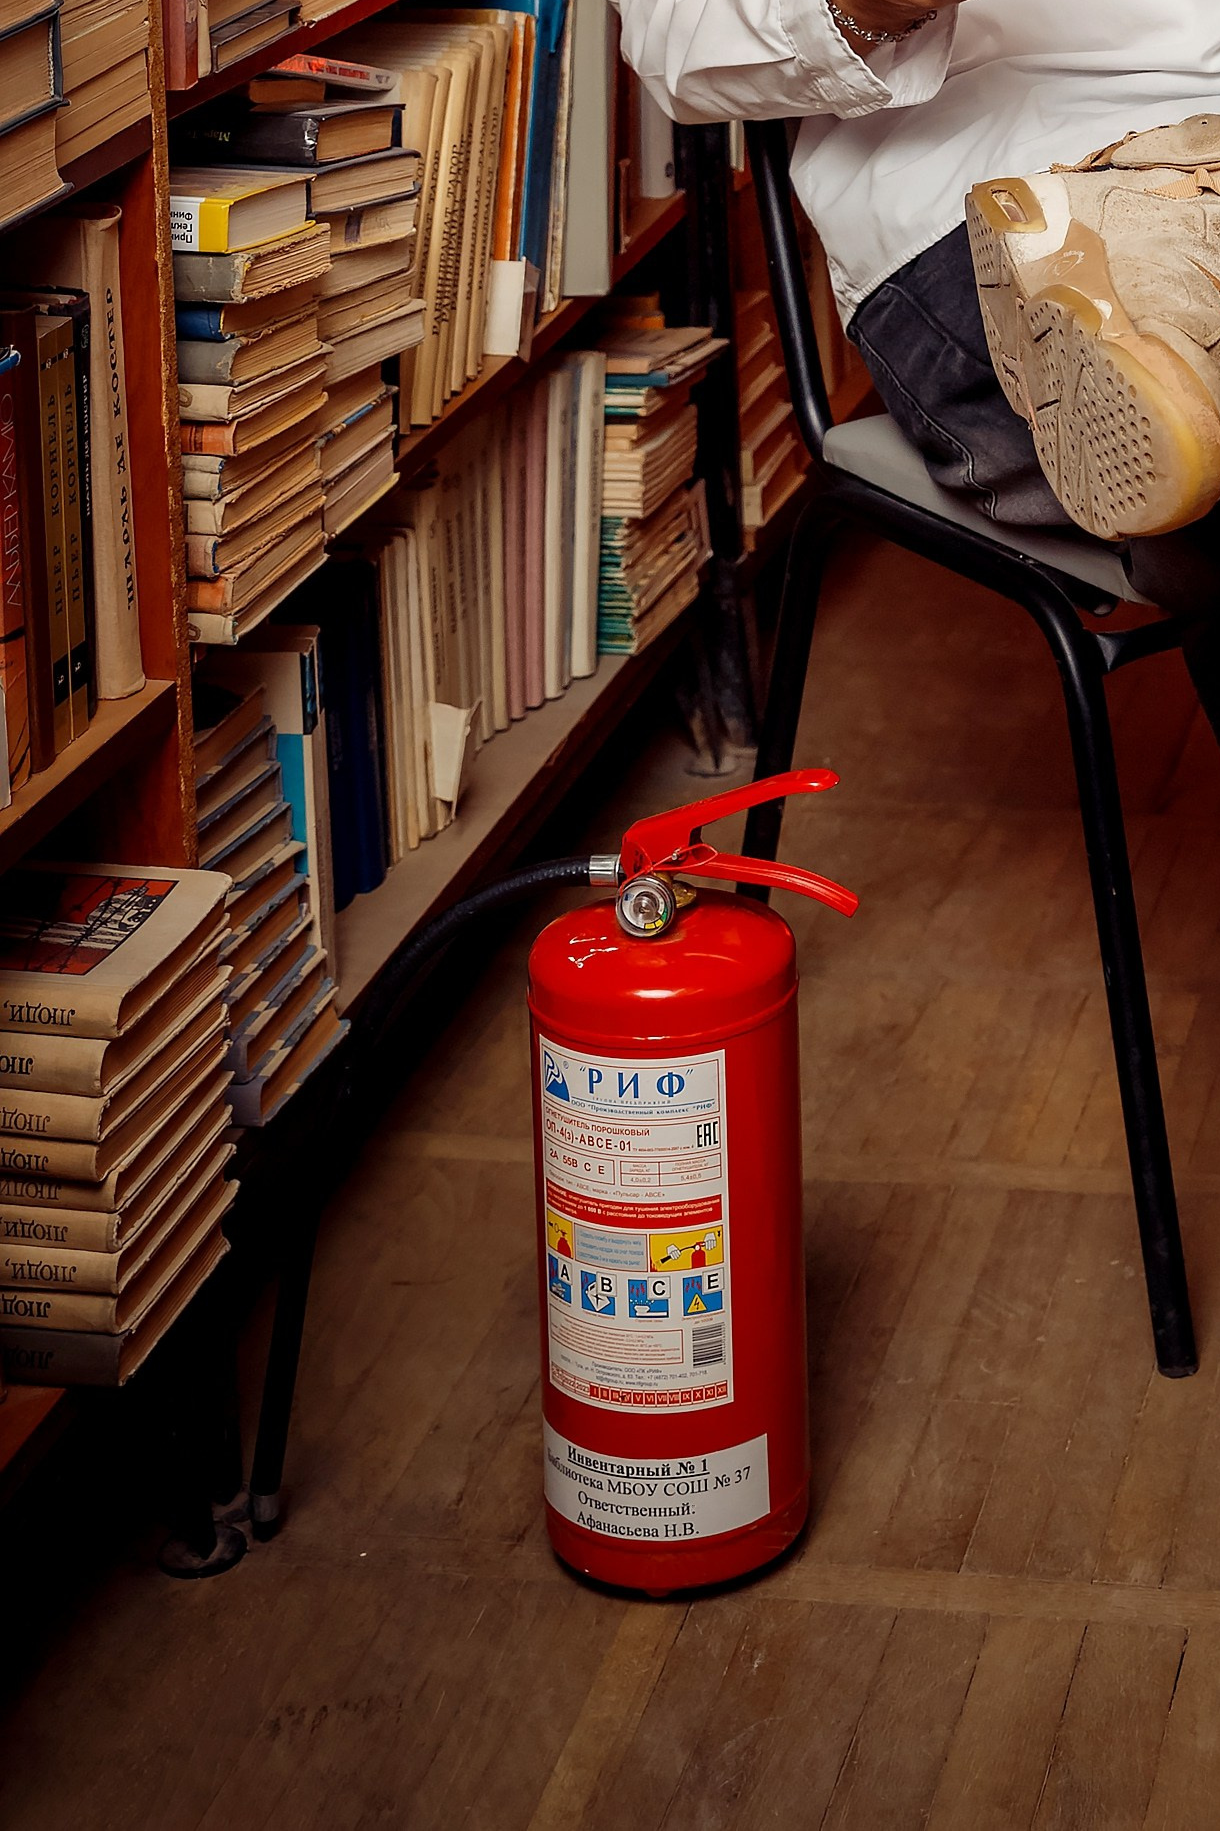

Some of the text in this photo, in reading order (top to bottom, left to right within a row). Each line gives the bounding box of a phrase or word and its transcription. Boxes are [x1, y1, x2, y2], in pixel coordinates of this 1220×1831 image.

[428, 149, 440, 205] ТАГОР
[432, 144, 459, 336] РАБИНДРАНАТ ТАГОР
[105, 286, 135, 610] ШАРЛЬ ДЕ КОСТЕР
[0, 393, 22, 607] АЛЬБЕР КАМЮ
[47, 392, 64, 616] ПЬЕР КОРНЕЛЬ
[64, 383, 81, 603] ПЬЕР КОРНЕЛЬ
[545, 1106, 650, 1136] ОГНЕТУШИТЕЛЬ ПОРОШКОВЫЙ
[560, 1265, 570, 1281] A
[601, 1276, 613, 1293] B
[652, 1280, 665, 1296] C
[707, 1273, 719, 1289] E
[567, 1445, 708, 1478] Инвентарный № 1
[607, 1479, 658, 1497] МБОУ
[663, 1479, 708, 1497] СОШ
[713, 1474, 731, 1490] №
[734, 1466, 751, 1484] 37
[578, 1491, 696, 1517] Ответственный:
[576, 1511, 700, 1538] Афанасьева Н.В.
